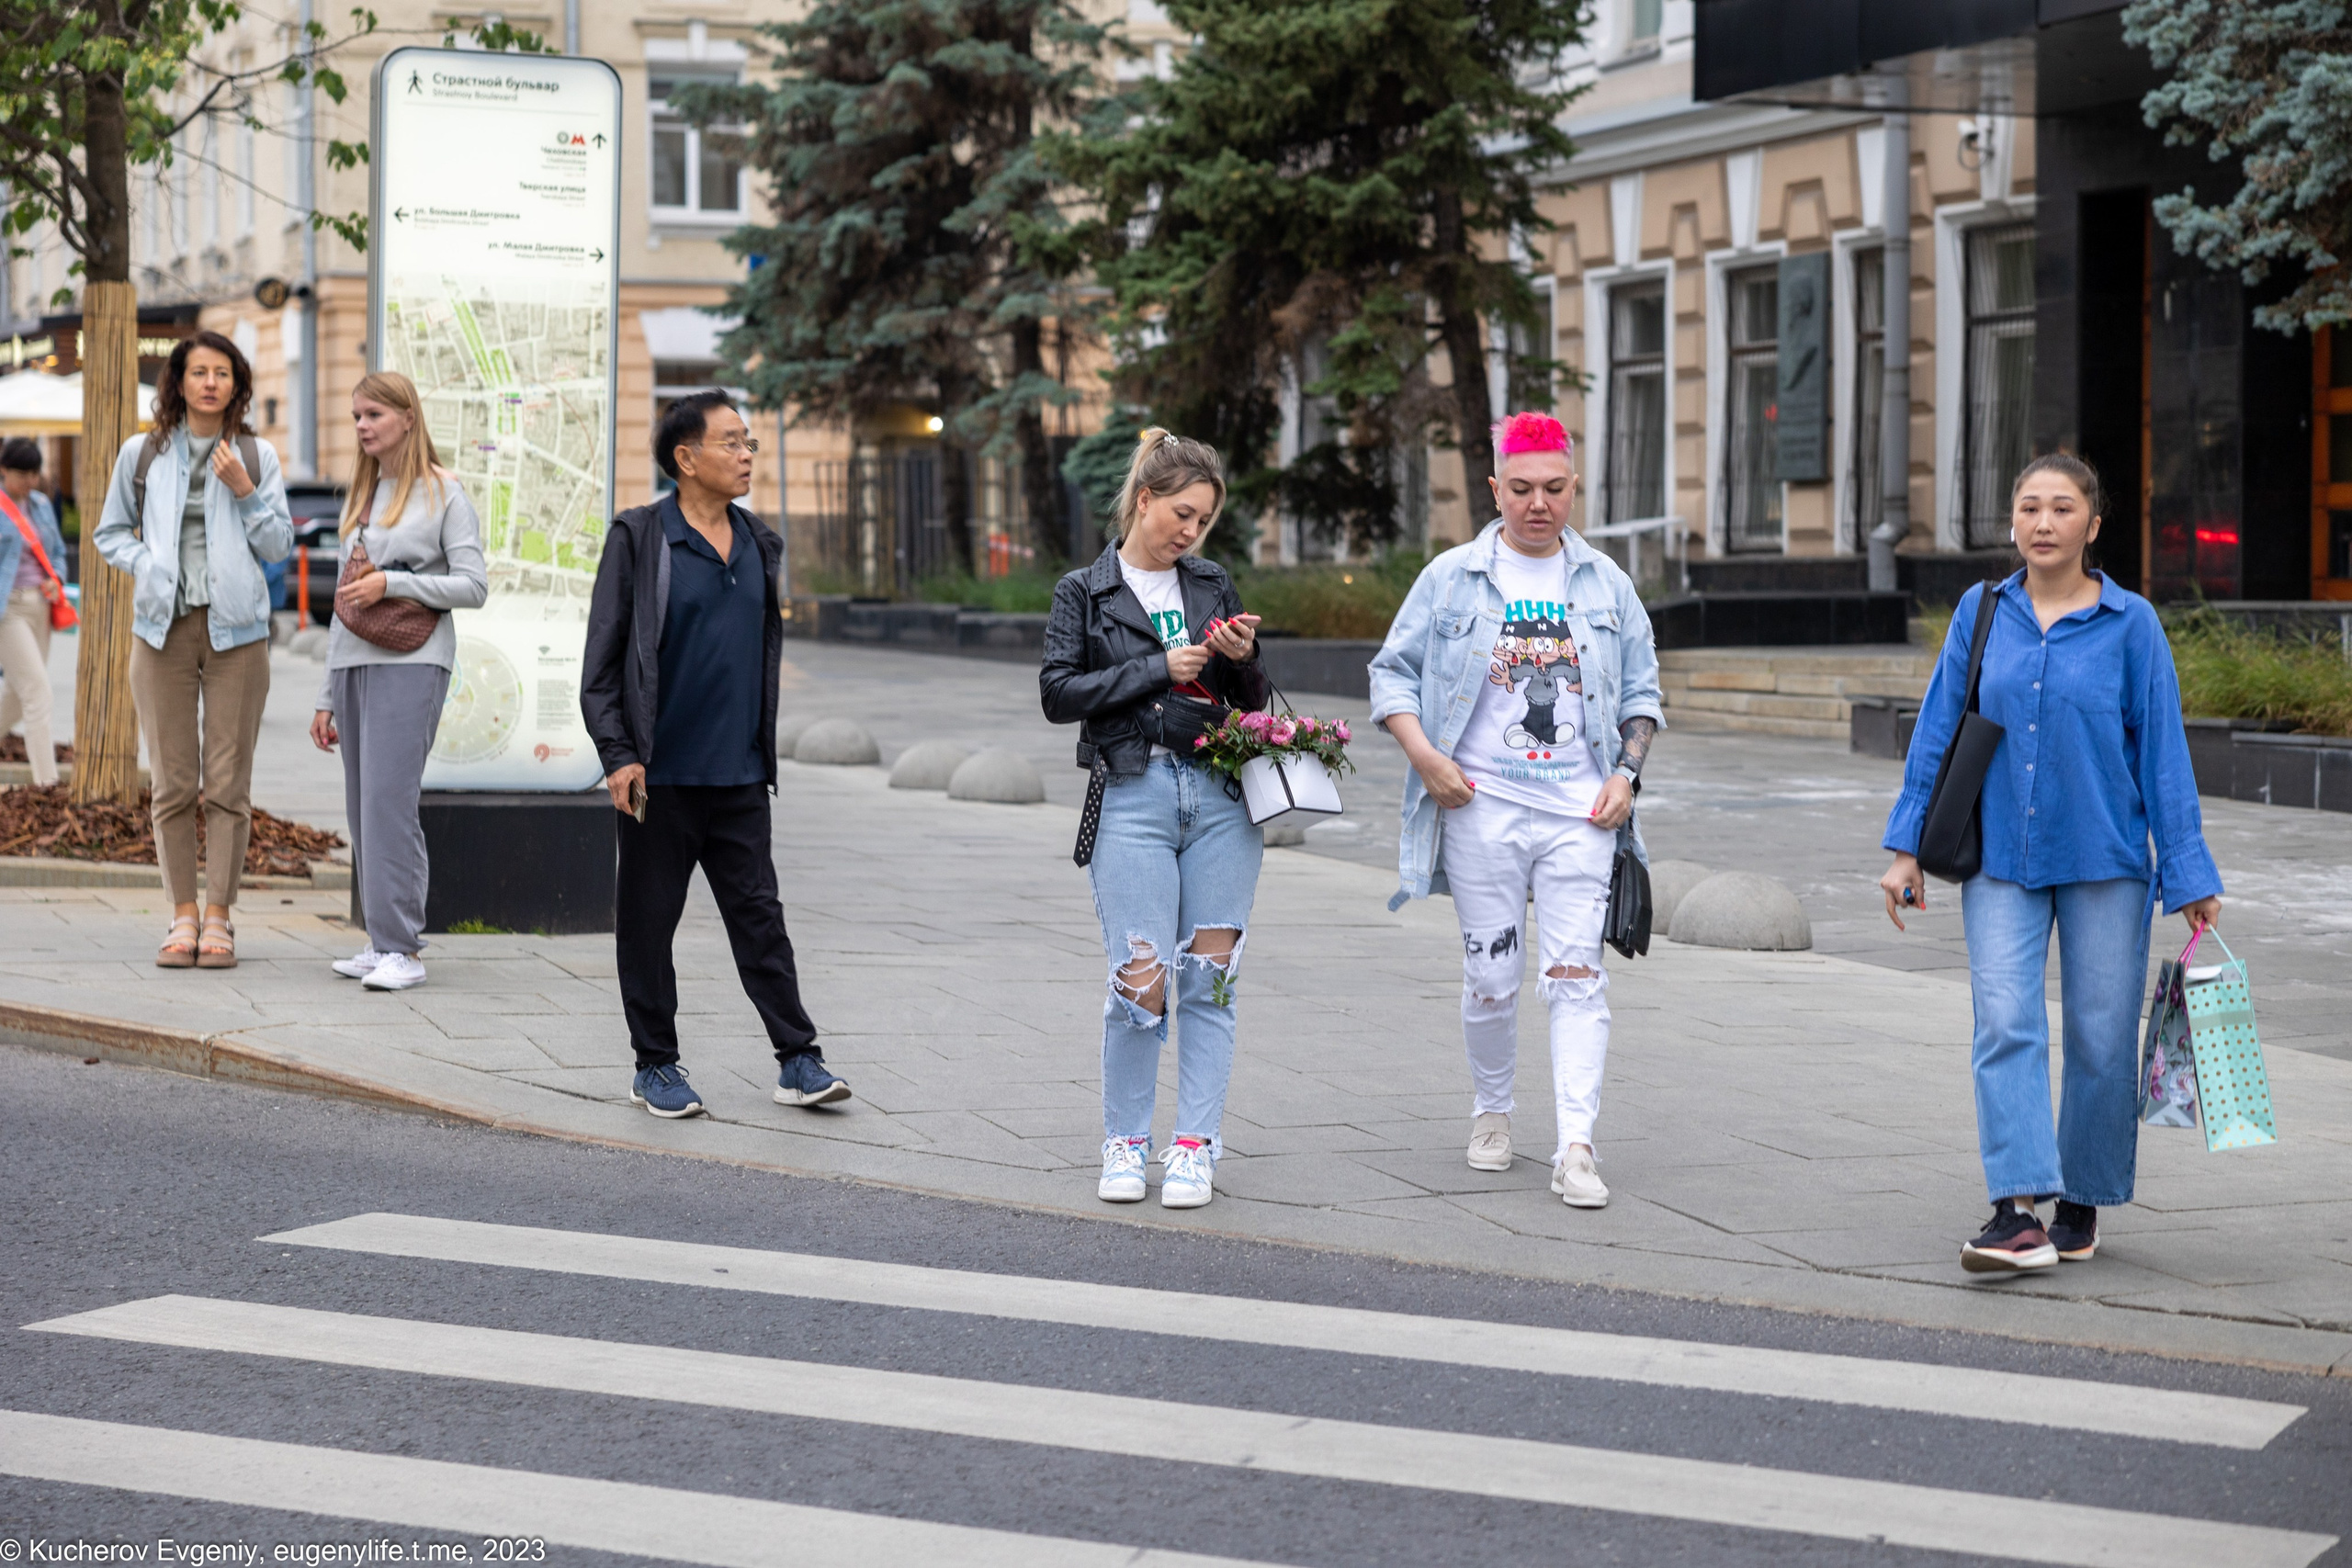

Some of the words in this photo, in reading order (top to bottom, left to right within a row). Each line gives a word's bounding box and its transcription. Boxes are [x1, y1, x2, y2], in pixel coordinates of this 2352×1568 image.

[432, 72, 502, 87] Страстной
[505, 75, 560, 93] бульвар
[474, 90, 518, 102] Boulevard
[560, 185, 586, 194] улица
[429, 206, 469, 217] Большая
[469, 208, 521, 220] Дмитровка
[503, 241, 534, 251] Малая
[535, 243, 585, 254] Дмитровка
[1537, 623, 1547, 631] N
[1500, 766, 1530, 780] YOUR
[1535, 768, 1571, 781] BRAND
